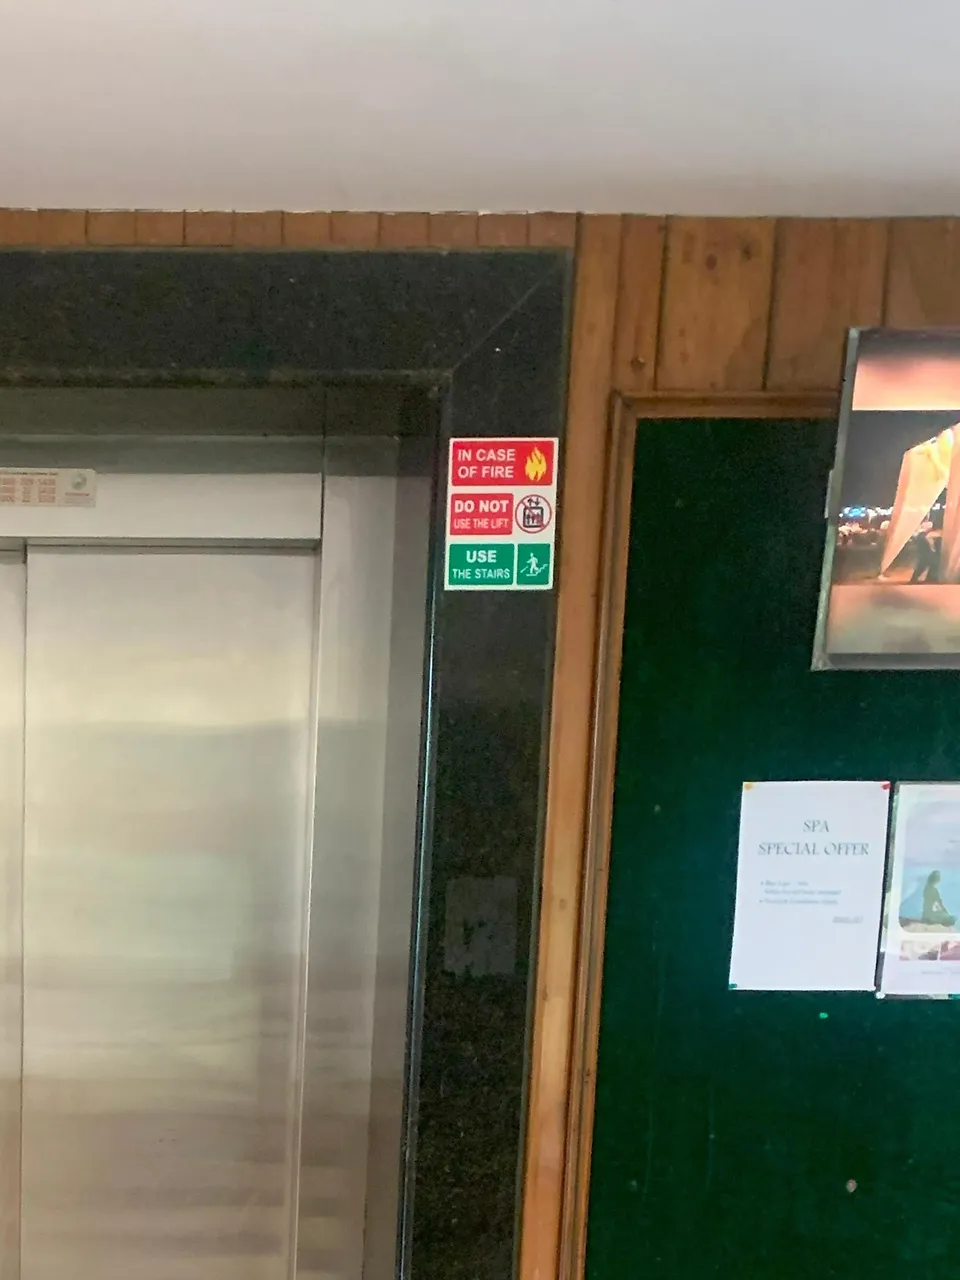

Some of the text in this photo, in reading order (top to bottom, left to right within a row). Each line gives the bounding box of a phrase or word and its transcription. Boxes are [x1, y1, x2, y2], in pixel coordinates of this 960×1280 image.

[458, 449, 516, 461] IN CASE
[458, 466, 514, 478] OF FIRE
[454, 500, 509, 513] DO NOT
[454, 518, 509, 529] USE THE LIFT
[466, 550, 497, 563] USE
[452, 568, 511, 579] THE STAIRS
[803, 820, 830, 833] SPA
[758, 842, 869, 856] SPECIAL OFFER
